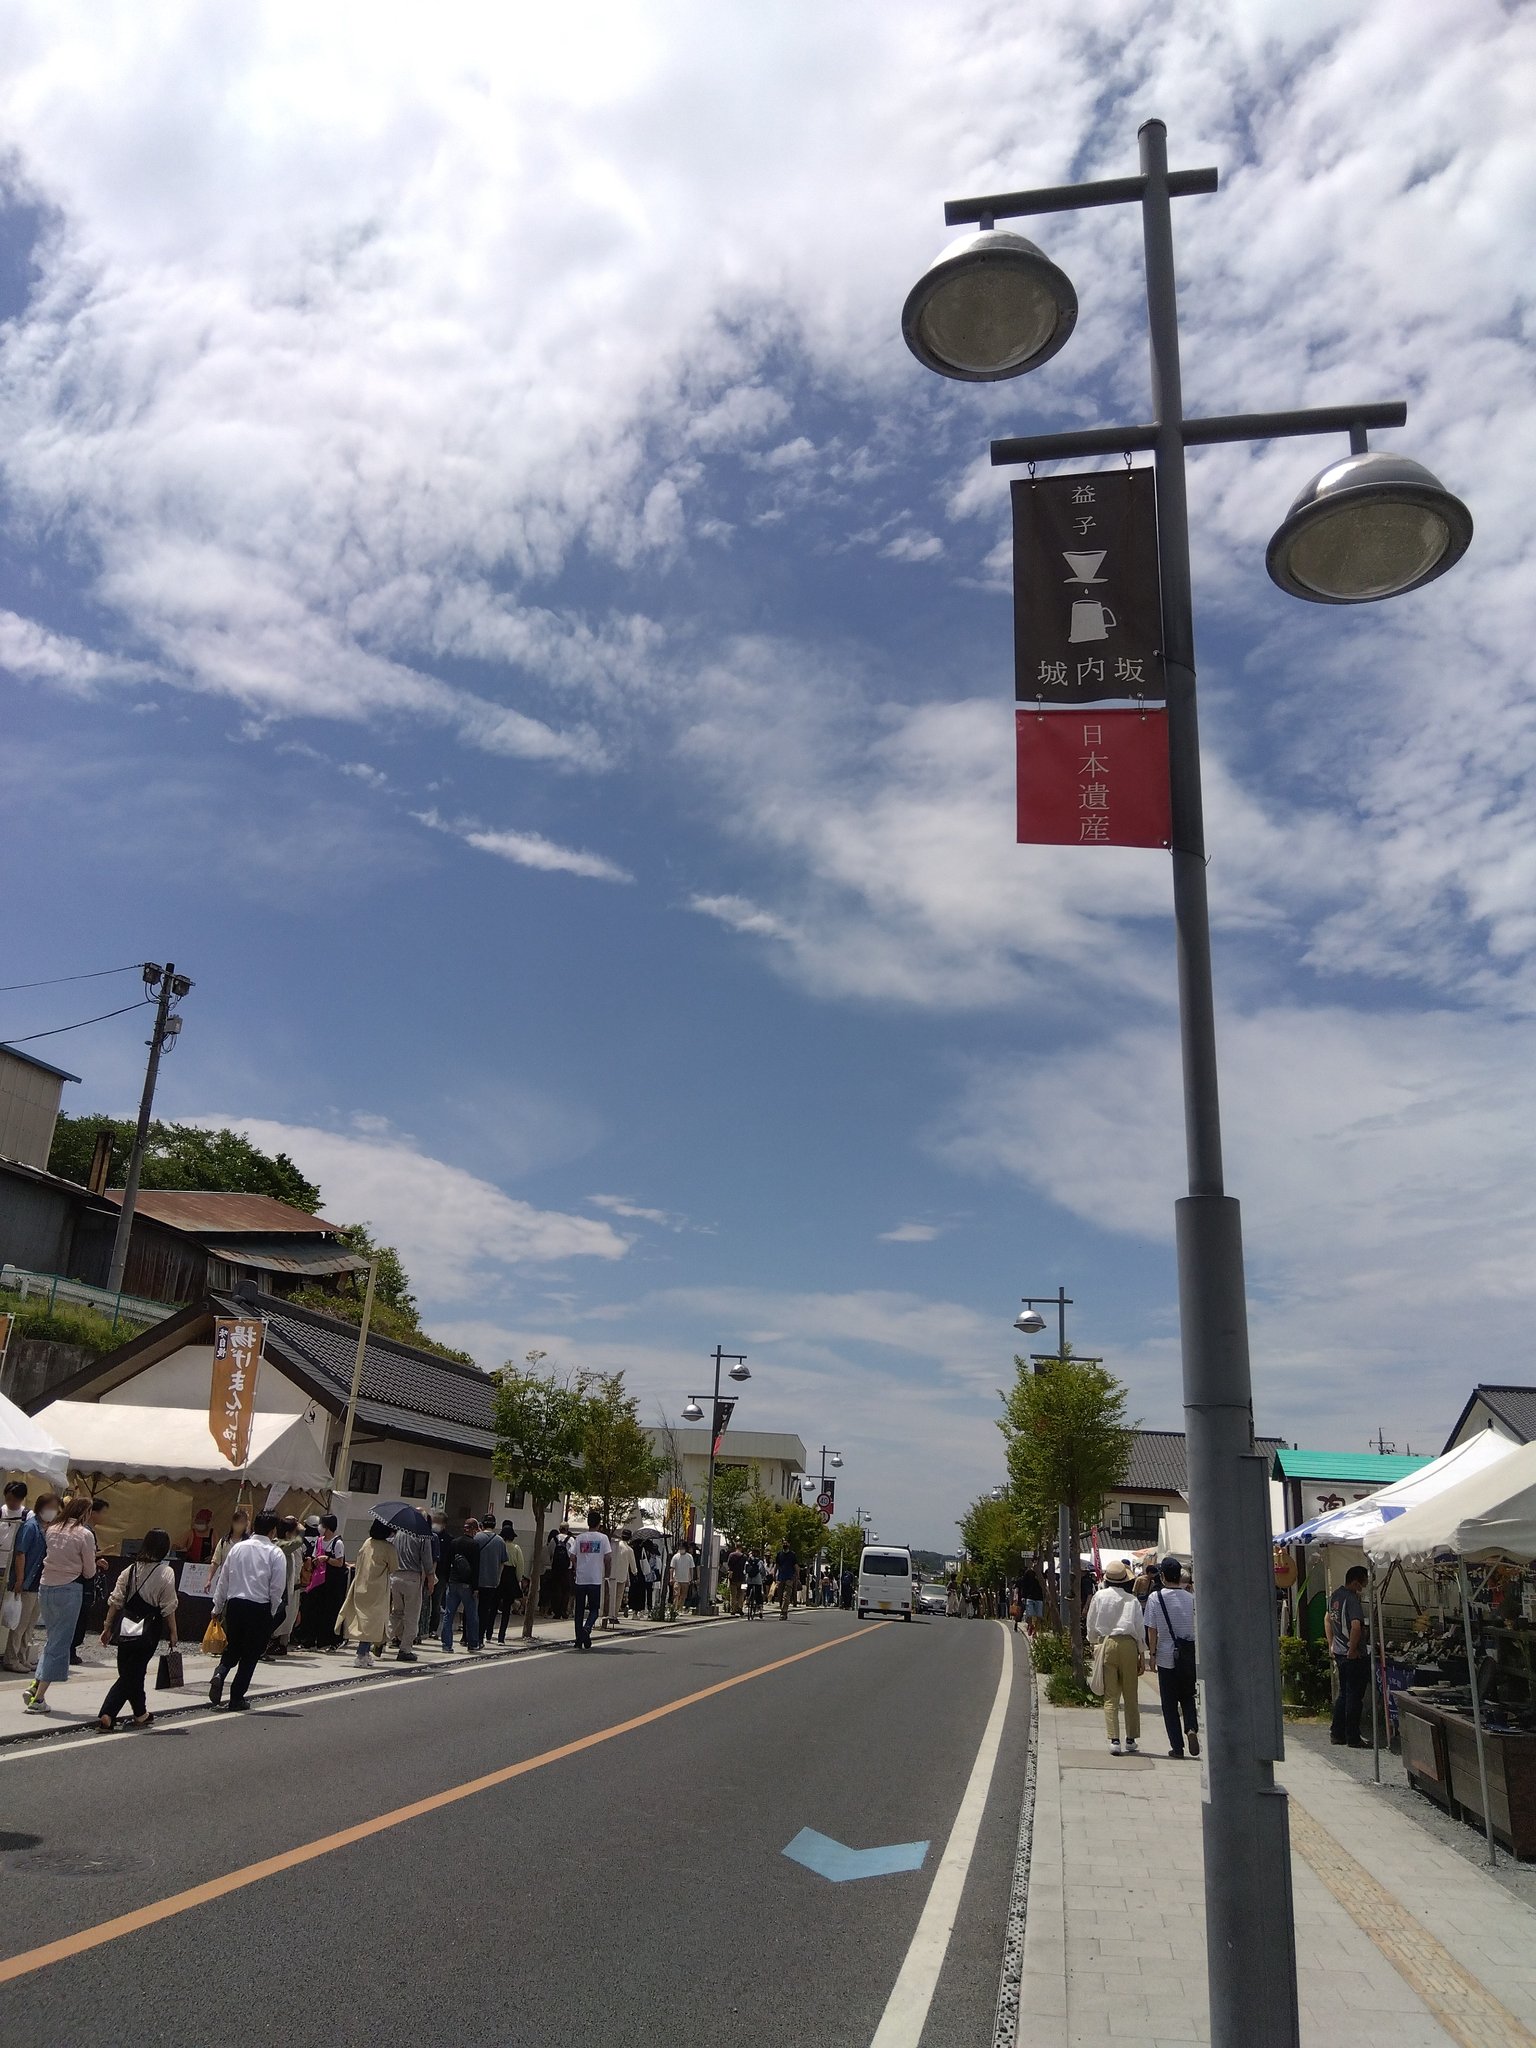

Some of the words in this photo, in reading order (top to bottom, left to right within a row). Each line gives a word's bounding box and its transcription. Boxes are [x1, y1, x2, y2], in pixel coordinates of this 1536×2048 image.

[1071, 484, 1097, 536] 益子
[1036, 656, 1146, 687] 城内坂
[1077, 724, 1110, 842] 日本遺産
